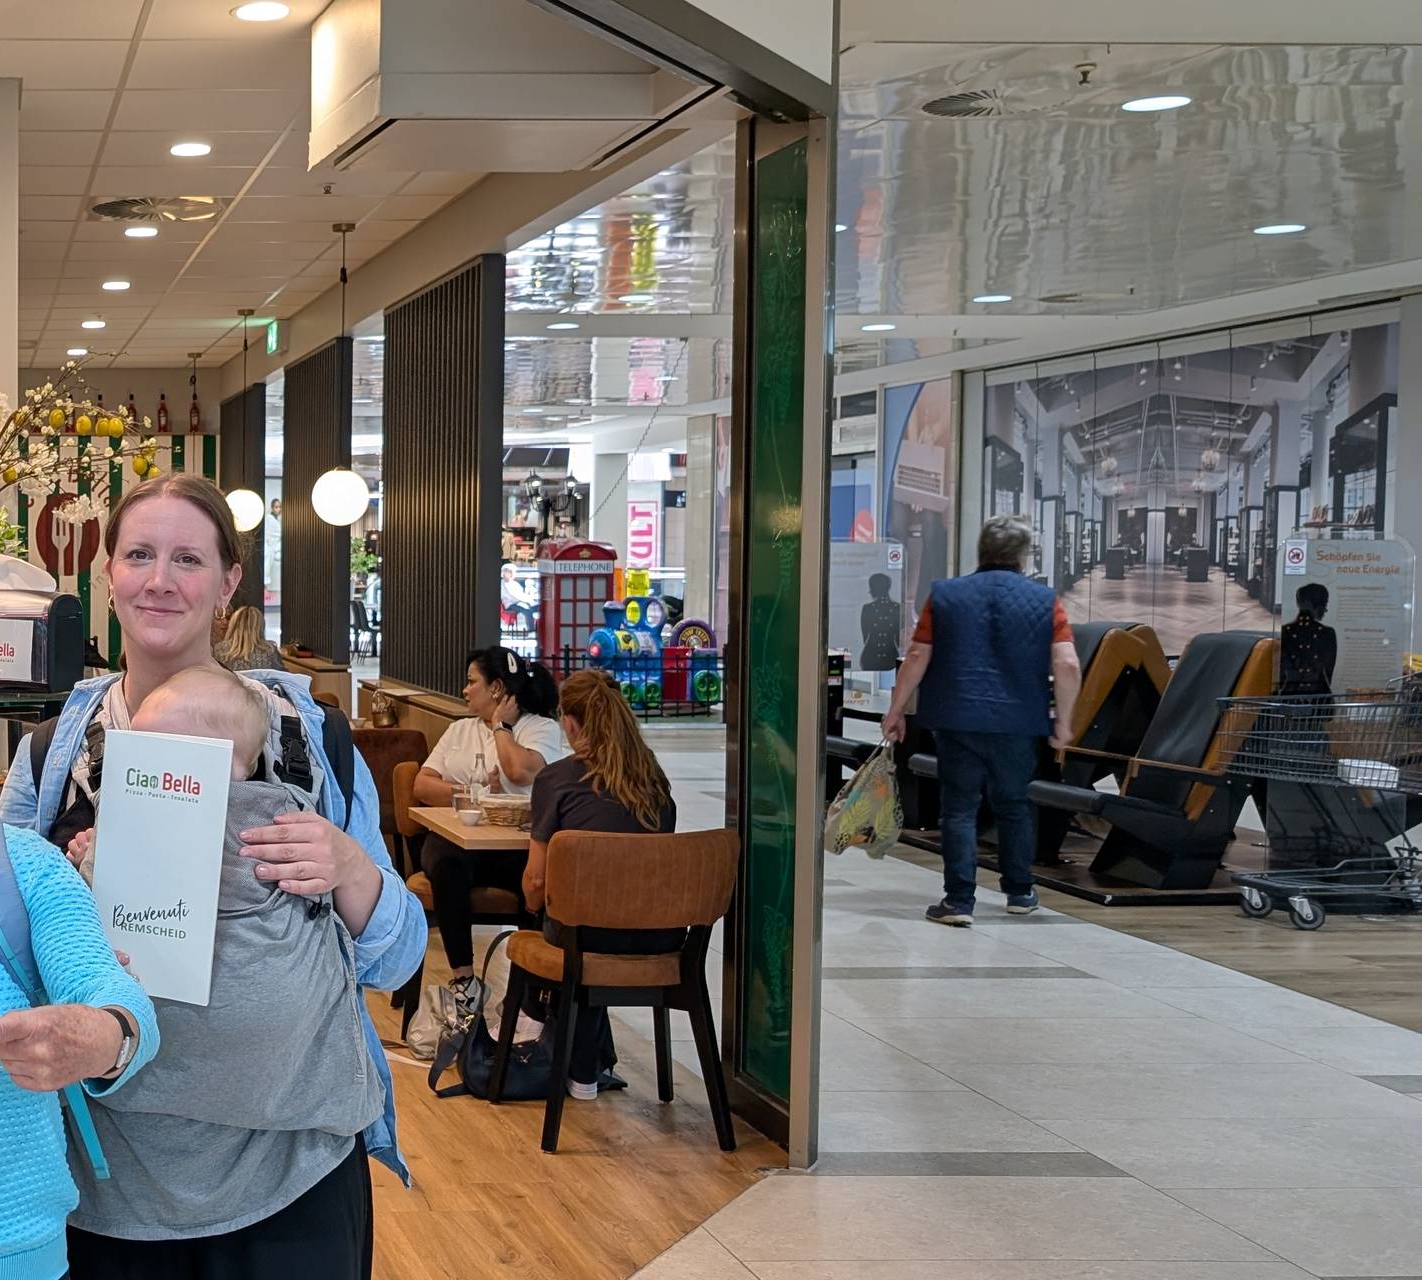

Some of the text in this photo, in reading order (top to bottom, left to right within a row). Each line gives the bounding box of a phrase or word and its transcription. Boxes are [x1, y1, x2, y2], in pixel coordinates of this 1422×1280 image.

[1366, 552, 1382, 561] Sie
[558, 562, 611, 572] TELEPHONE
[1336, 564, 1401, 575] neue Energie
[125, 767, 201, 796] Ciao Bella
[113, 898, 190, 928] Benvenuti
[120, 922, 188, 940] REMSCHEID
